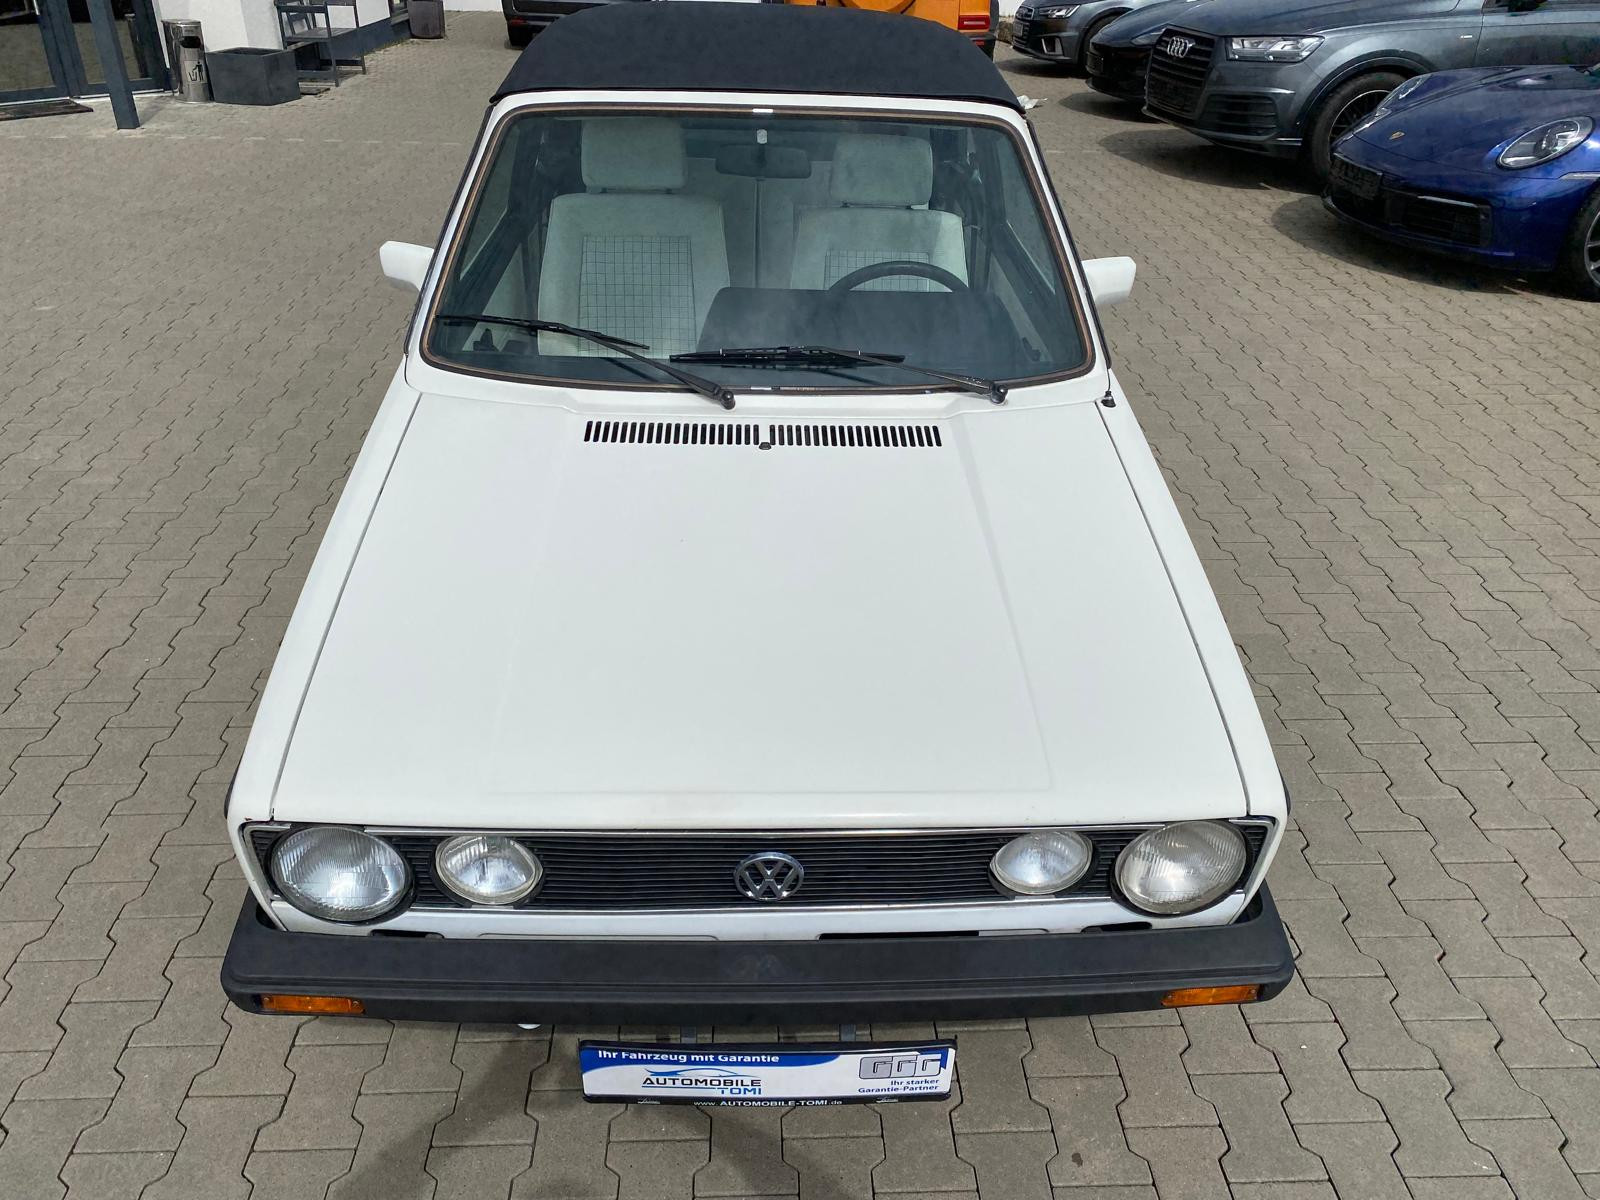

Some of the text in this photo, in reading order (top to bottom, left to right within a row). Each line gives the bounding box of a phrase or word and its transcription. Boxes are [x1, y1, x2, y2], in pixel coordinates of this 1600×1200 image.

[735, 853, 803, 901] VW
[598, 1050, 780, 1063] Ihr Fahrzeug mit Garantie
[859, 1054, 942, 1080] GGG
[642, 1077, 762, 1087] AUTOMOBILE
[717, 1087, 762, 1096] TOMI
[858, 1085, 939, 1094] Garantie-Partner
